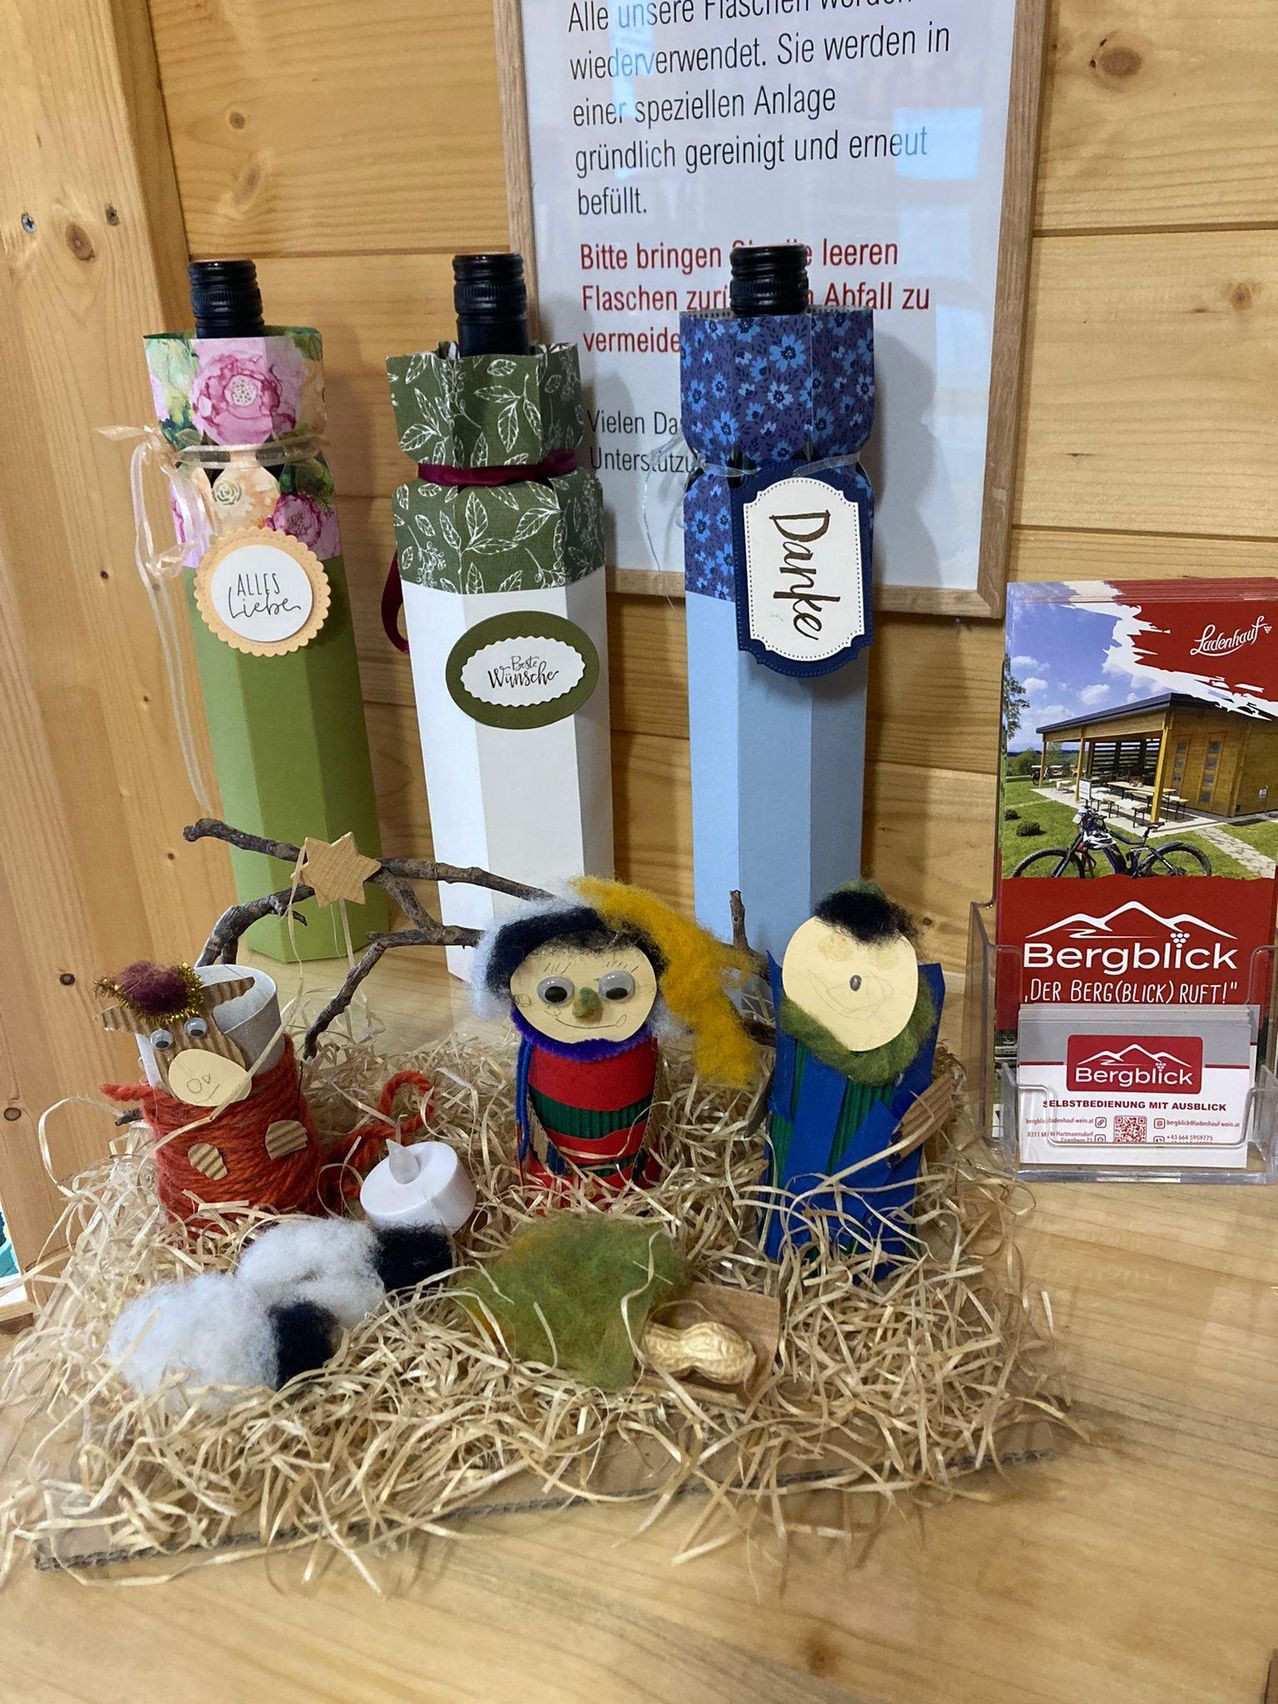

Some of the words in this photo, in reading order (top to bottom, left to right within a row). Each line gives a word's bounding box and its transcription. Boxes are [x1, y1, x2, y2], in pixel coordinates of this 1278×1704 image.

[568, 0, 609, 33] Alle
[618, 0, 694, 29] unsere
[570, 37, 766, 80] wiederverwendet.
[777, 32, 815, 64] Sie
[824, 25, 916, 61] werden
[928, 21, 950, 52] in
[573, 97, 627, 126] einer
[635, 88, 744, 129] speziellen
[754, 83, 836, 120] Anlage
[576, 138, 676, 179] gründlich
[685, 133, 785, 174] gereinigt
[794, 129, 838, 161] und
[850, 126, 928, 159] erneut
[578, 186, 648, 215] befüllt.
[580, 243, 628, 270] Bitte
[636, 242, 722, 275] bringen
[822, 238, 898, 266] leeren
[582, 284, 678, 311] Flaschen
[825, 281, 893, 310] Abfall
[901, 287, 930, 310] zu
[583, 327, 681, 353] vermeide
[587, 410, 645, 434] Vielen
[237, 572, 280, 596] ALLES
[769, 509, 841, 641] Danke
[228, 586, 302, 619] Liebe
[1189, 615, 1268, 657] Ladenhauf
[487, 660, 560, 689] Wünsche
[510, 655, 540, 671] Beste
[1023, 942, 1238, 976] Bergblick
[1070, 979, 1175, 1004] BERG(BLICK)
[1075, 1066, 1193, 1088] Bergblick
[1042, 1099, 1146, 1110] SELBSTBEDIENUNG
[1149, 1101, 1169, 1110] MIT
[1172, 1101, 1227, 1112] AUSBLICK
